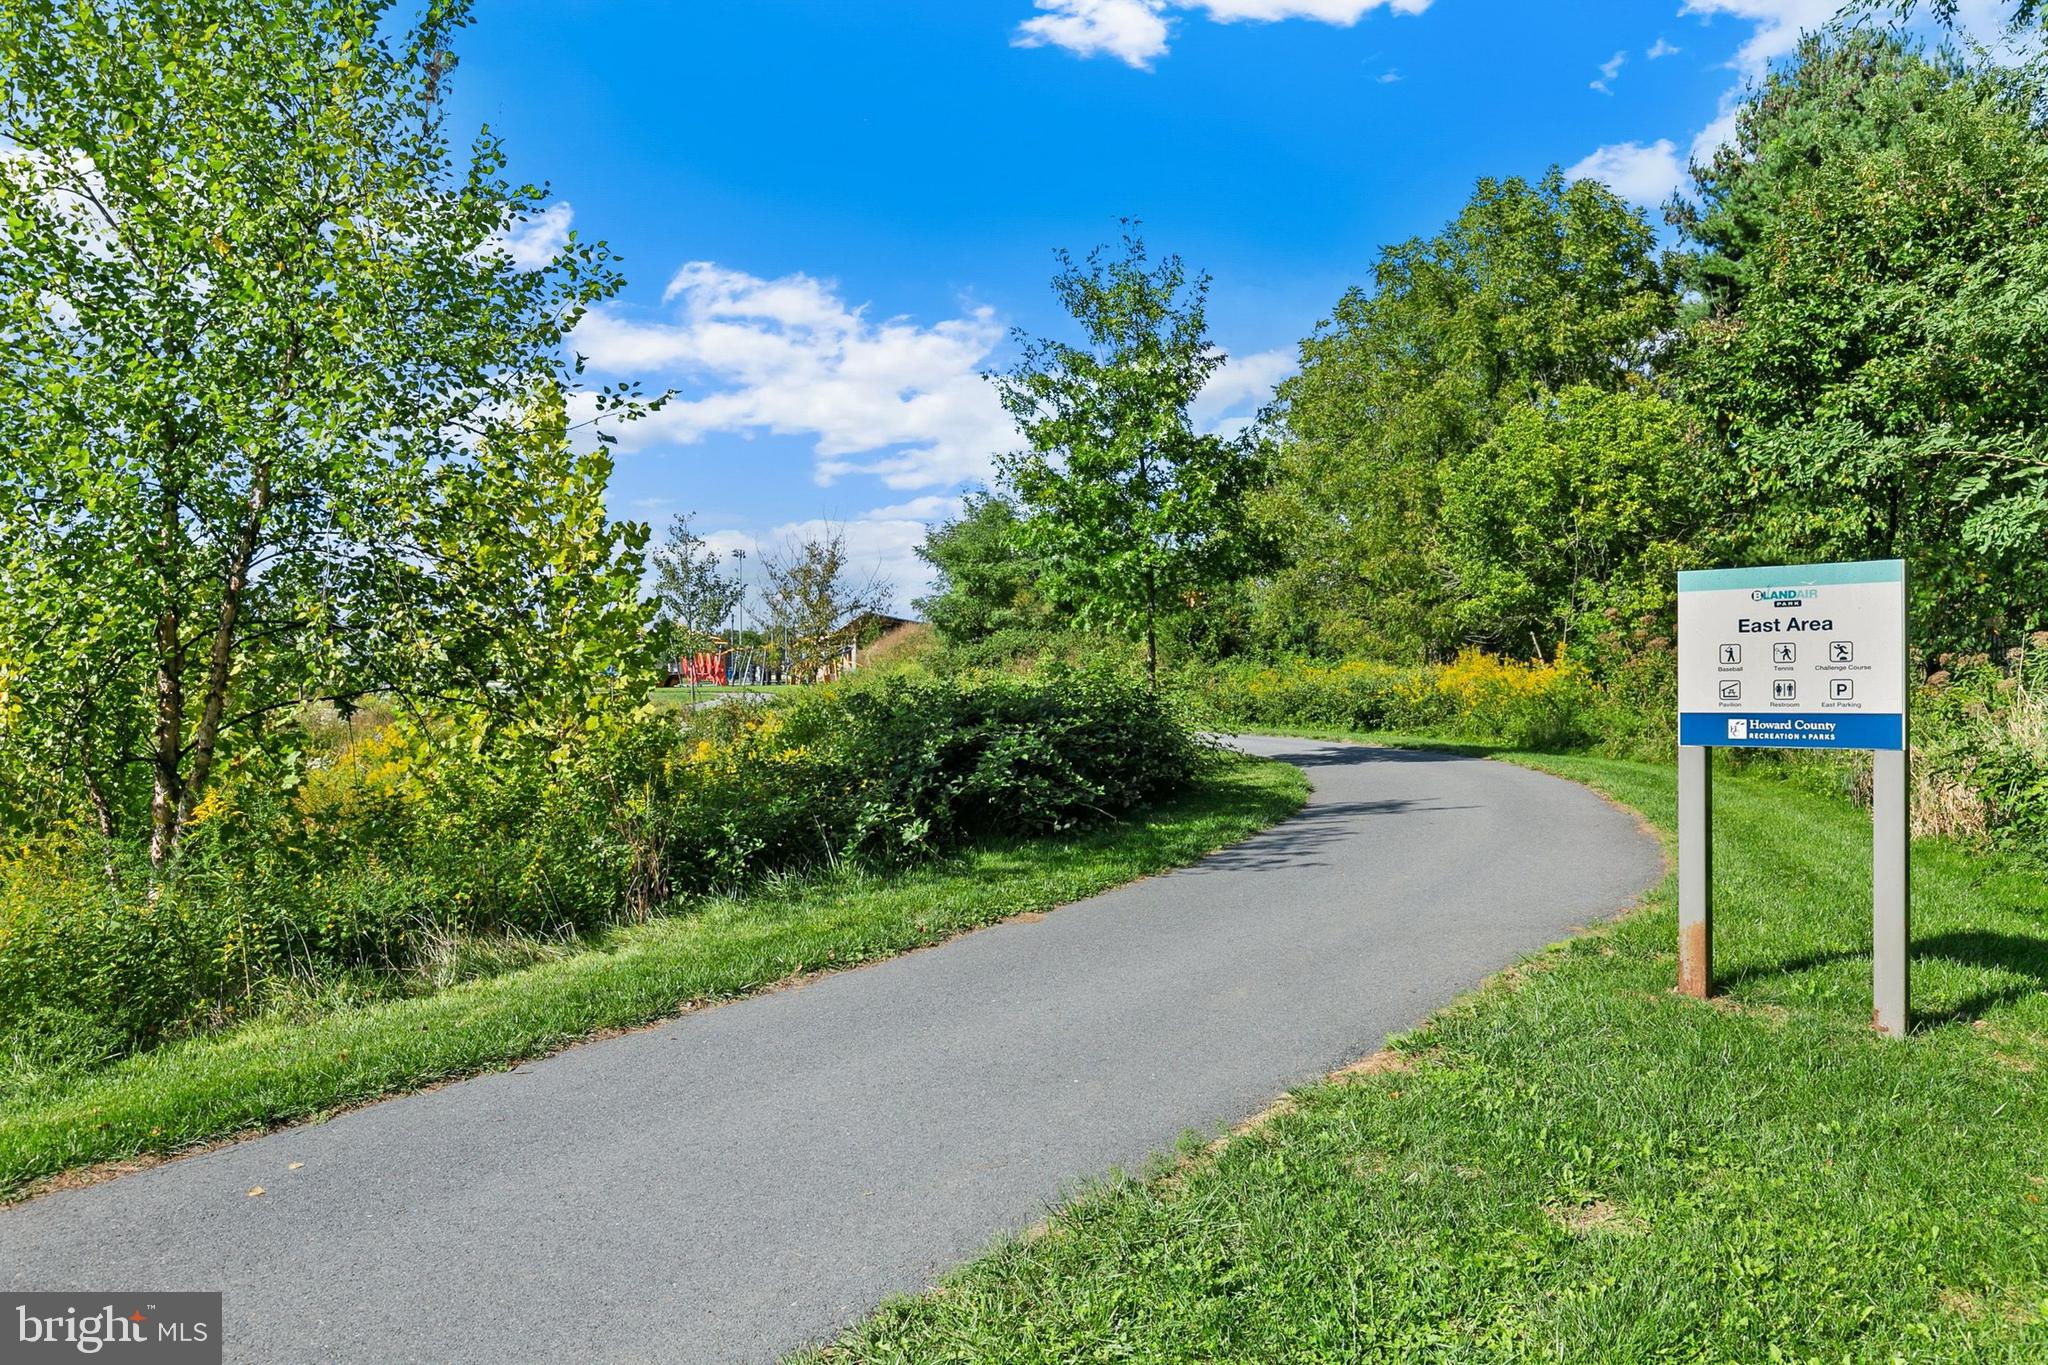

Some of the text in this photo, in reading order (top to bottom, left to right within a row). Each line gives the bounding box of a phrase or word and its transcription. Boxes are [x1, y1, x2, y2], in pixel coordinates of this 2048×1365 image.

[1751, 589, 1818, 601] BLANDAIR
[1738, 617, 1833, 633] East Area
[1750, 720, 1836, 732] Howard County
